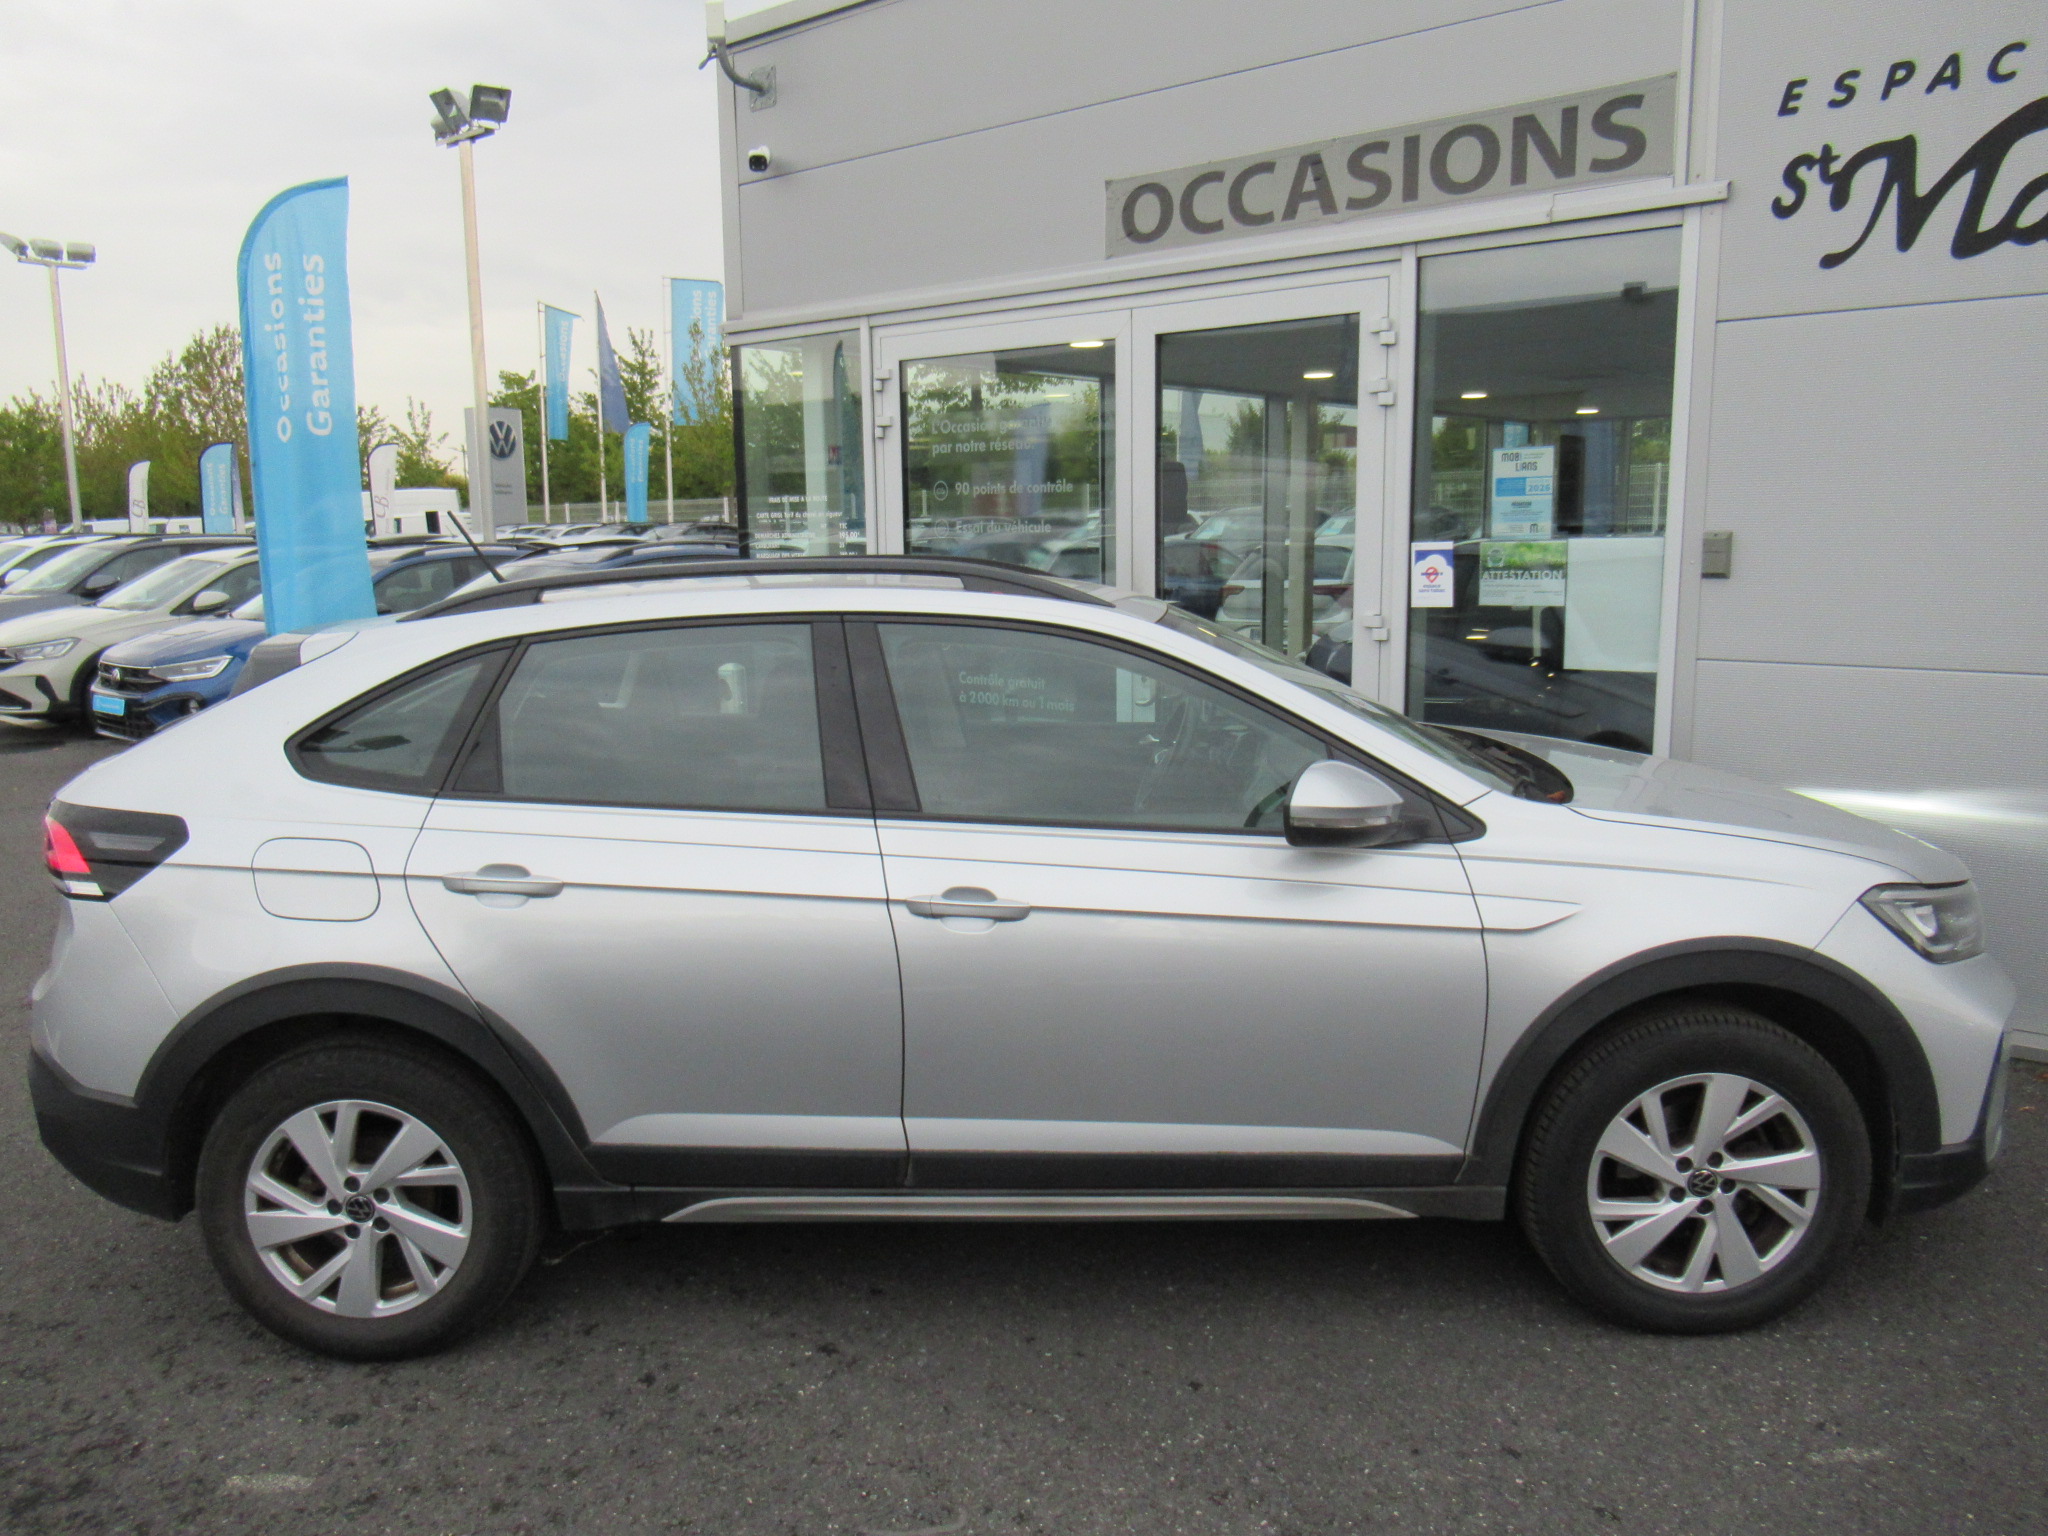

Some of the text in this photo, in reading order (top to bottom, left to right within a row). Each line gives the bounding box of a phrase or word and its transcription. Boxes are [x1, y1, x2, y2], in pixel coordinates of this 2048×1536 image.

[1121, 93, 1647, 244] OCCASIONS
[264, 253, 293, 443] Occasions
[298, 254, 333, 436] Garanties
[932, 443, 952, 457] par
[955, 441, 986, 453] notre
[955, 478, 1074, 497] 90 points de contrôle
[987, 519, 1001, 533] du
[1005, 519, 1052, 533] véhicule
[1482, 570, 1563, 581] ATTESTATION
[959, 671, 1045, 691] Contrôle gratuit
[1002, 695, 1019, 707] km
[1022, 699, 1035, 709] ou
[1047, 697, 1075, 712] mois
